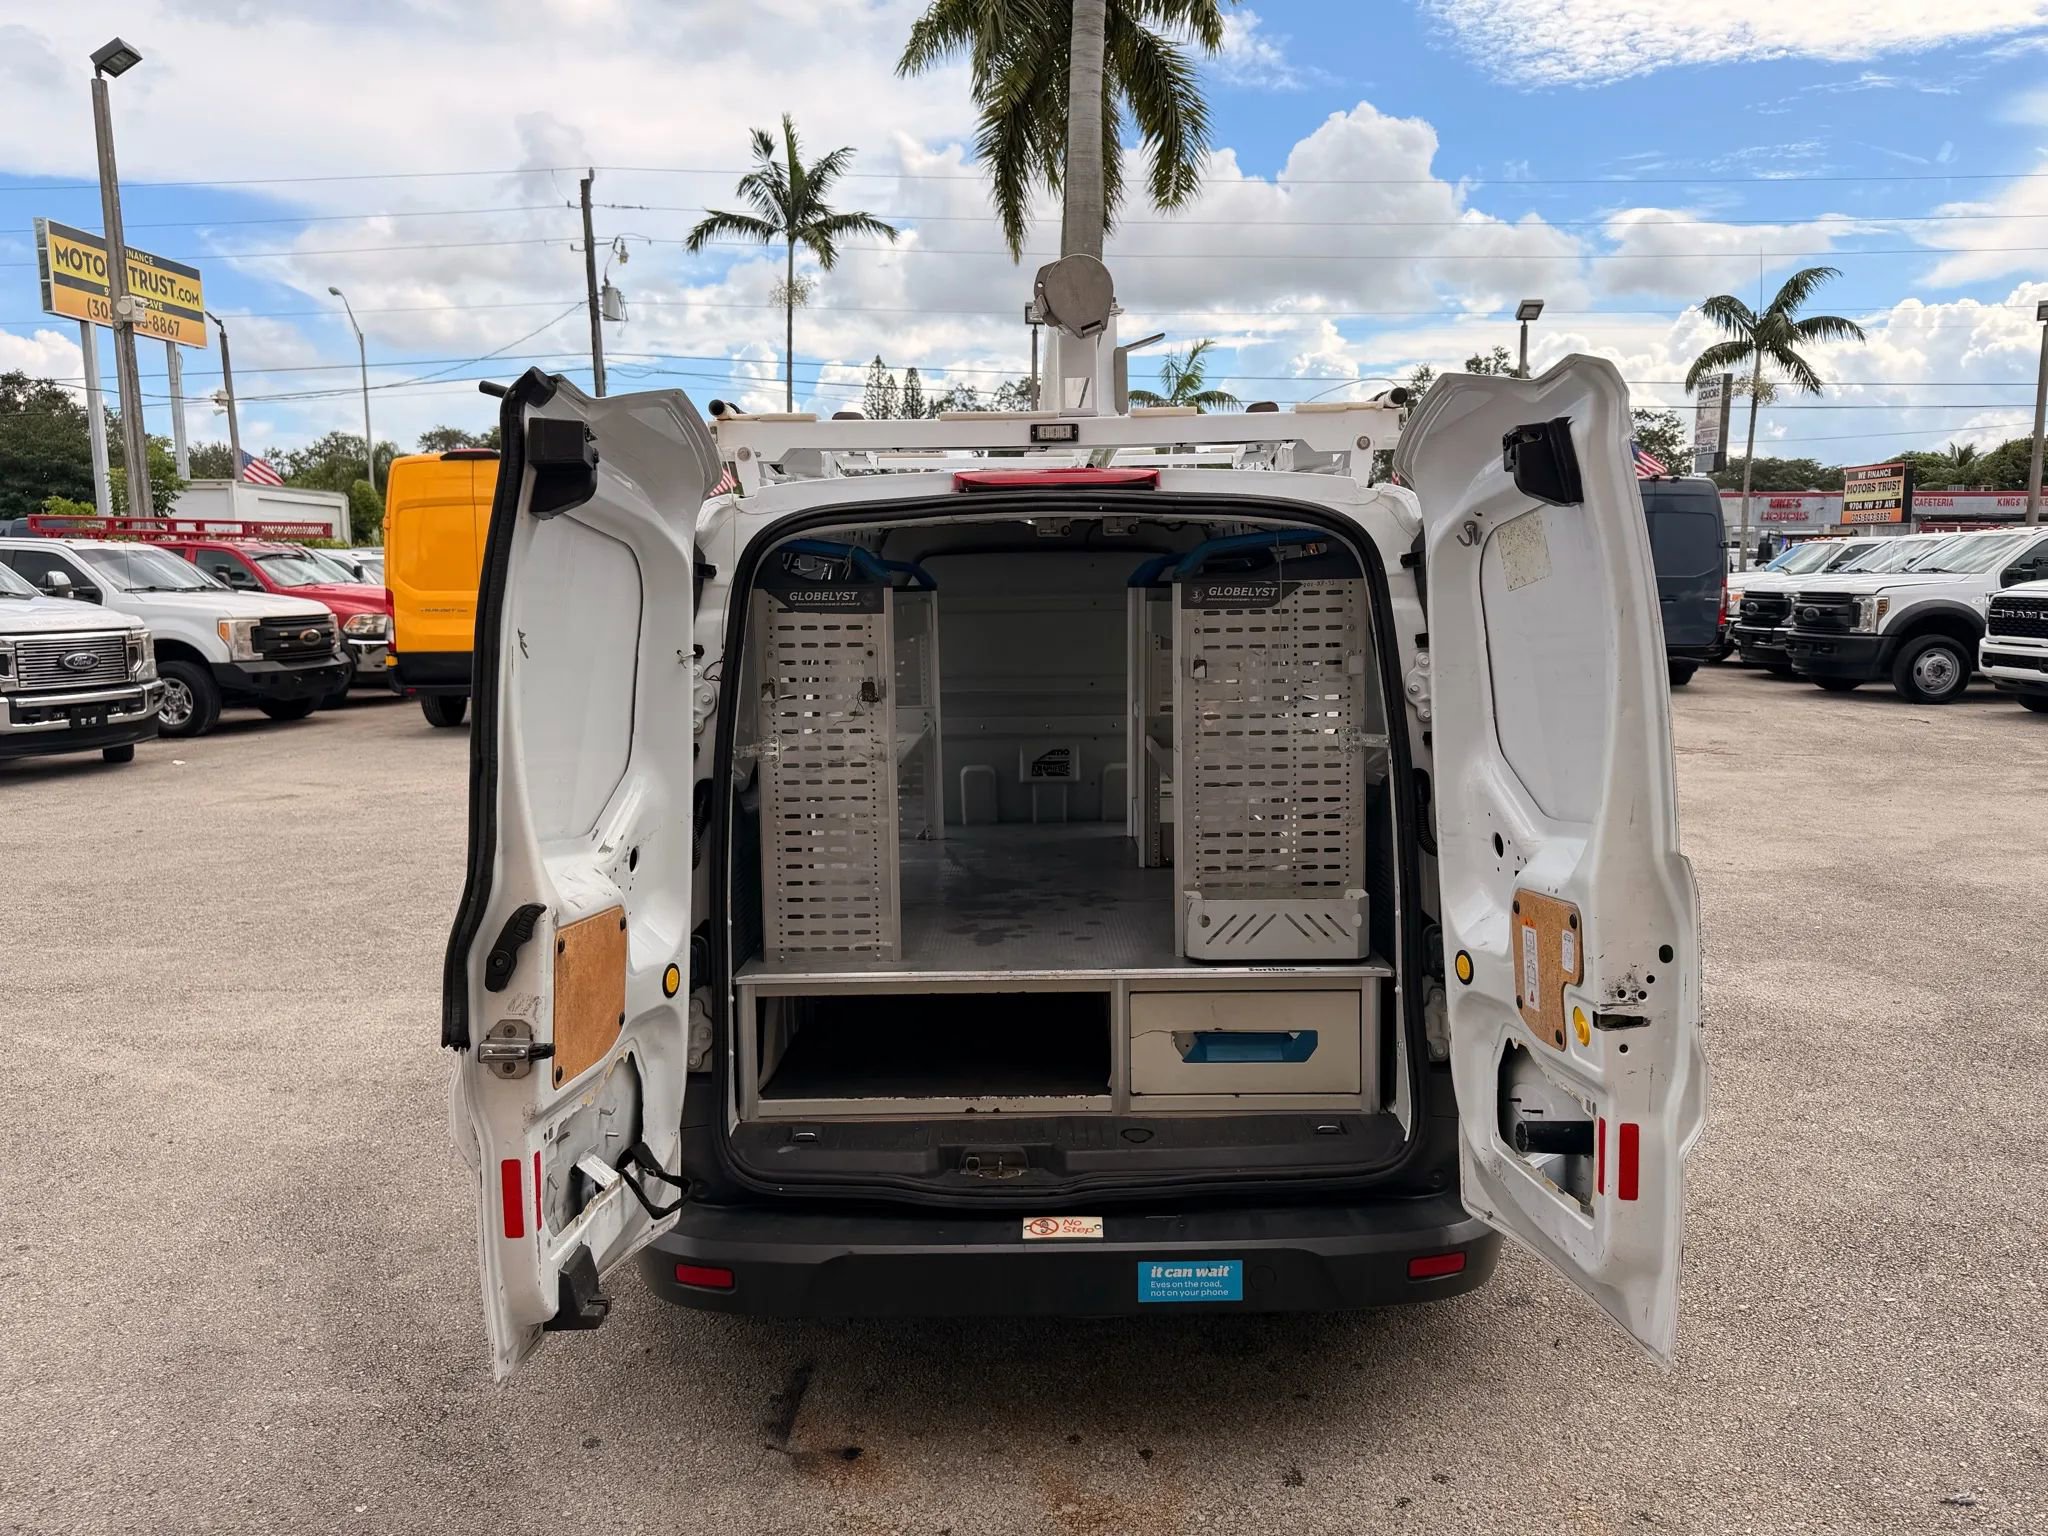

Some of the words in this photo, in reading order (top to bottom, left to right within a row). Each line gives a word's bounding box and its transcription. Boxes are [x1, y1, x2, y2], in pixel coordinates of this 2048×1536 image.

[55, 242, 109, 278] MOTO
[128, 264, 200, 306] TRUST.COM
[1857, 471, 1867, 480] WE
[1867, 468, 1892, 479] FINANCE
[1846, 482, 1876, 494] MOTORS
[1878, 480, 1902, 491] TRUST
[1849, 502, 1863, 510] 9704
[1863, 501, 1874, 509] NW
[1875, 500, 1883, 509] 27
[1884, 499, 1896, 508] AVE
[1914, 497, 1954, 507] CAFETERIA
[1997, 497, 2020, 507] KINGS
[789, 591, 858, 601] GLOBELYST
[1208, 586, 1278, 597] GLOBELYST
[2004, 610, 2037, 619] RAM
[72, 655, 94, 666] Ford
[1062, 1218, 1082, 1226] No
[1062, 1226, 1095, 1234] Step
[1151, 1265, 1163, 1278] it
[1164, 1268, 1193, 1278] can
[1195, 1265, 1230, 1277] wait
[1150, 1281, 1171, 1289] Eyes
[1184, 1280, 1199, 1288] the
[1200, 1280, 1222, 1288] road,
[1150, 1289, 1166, 1297] not
[1179, 1290, 1200, 1299] your
[1200, 1288, 1229, 1298] phone
